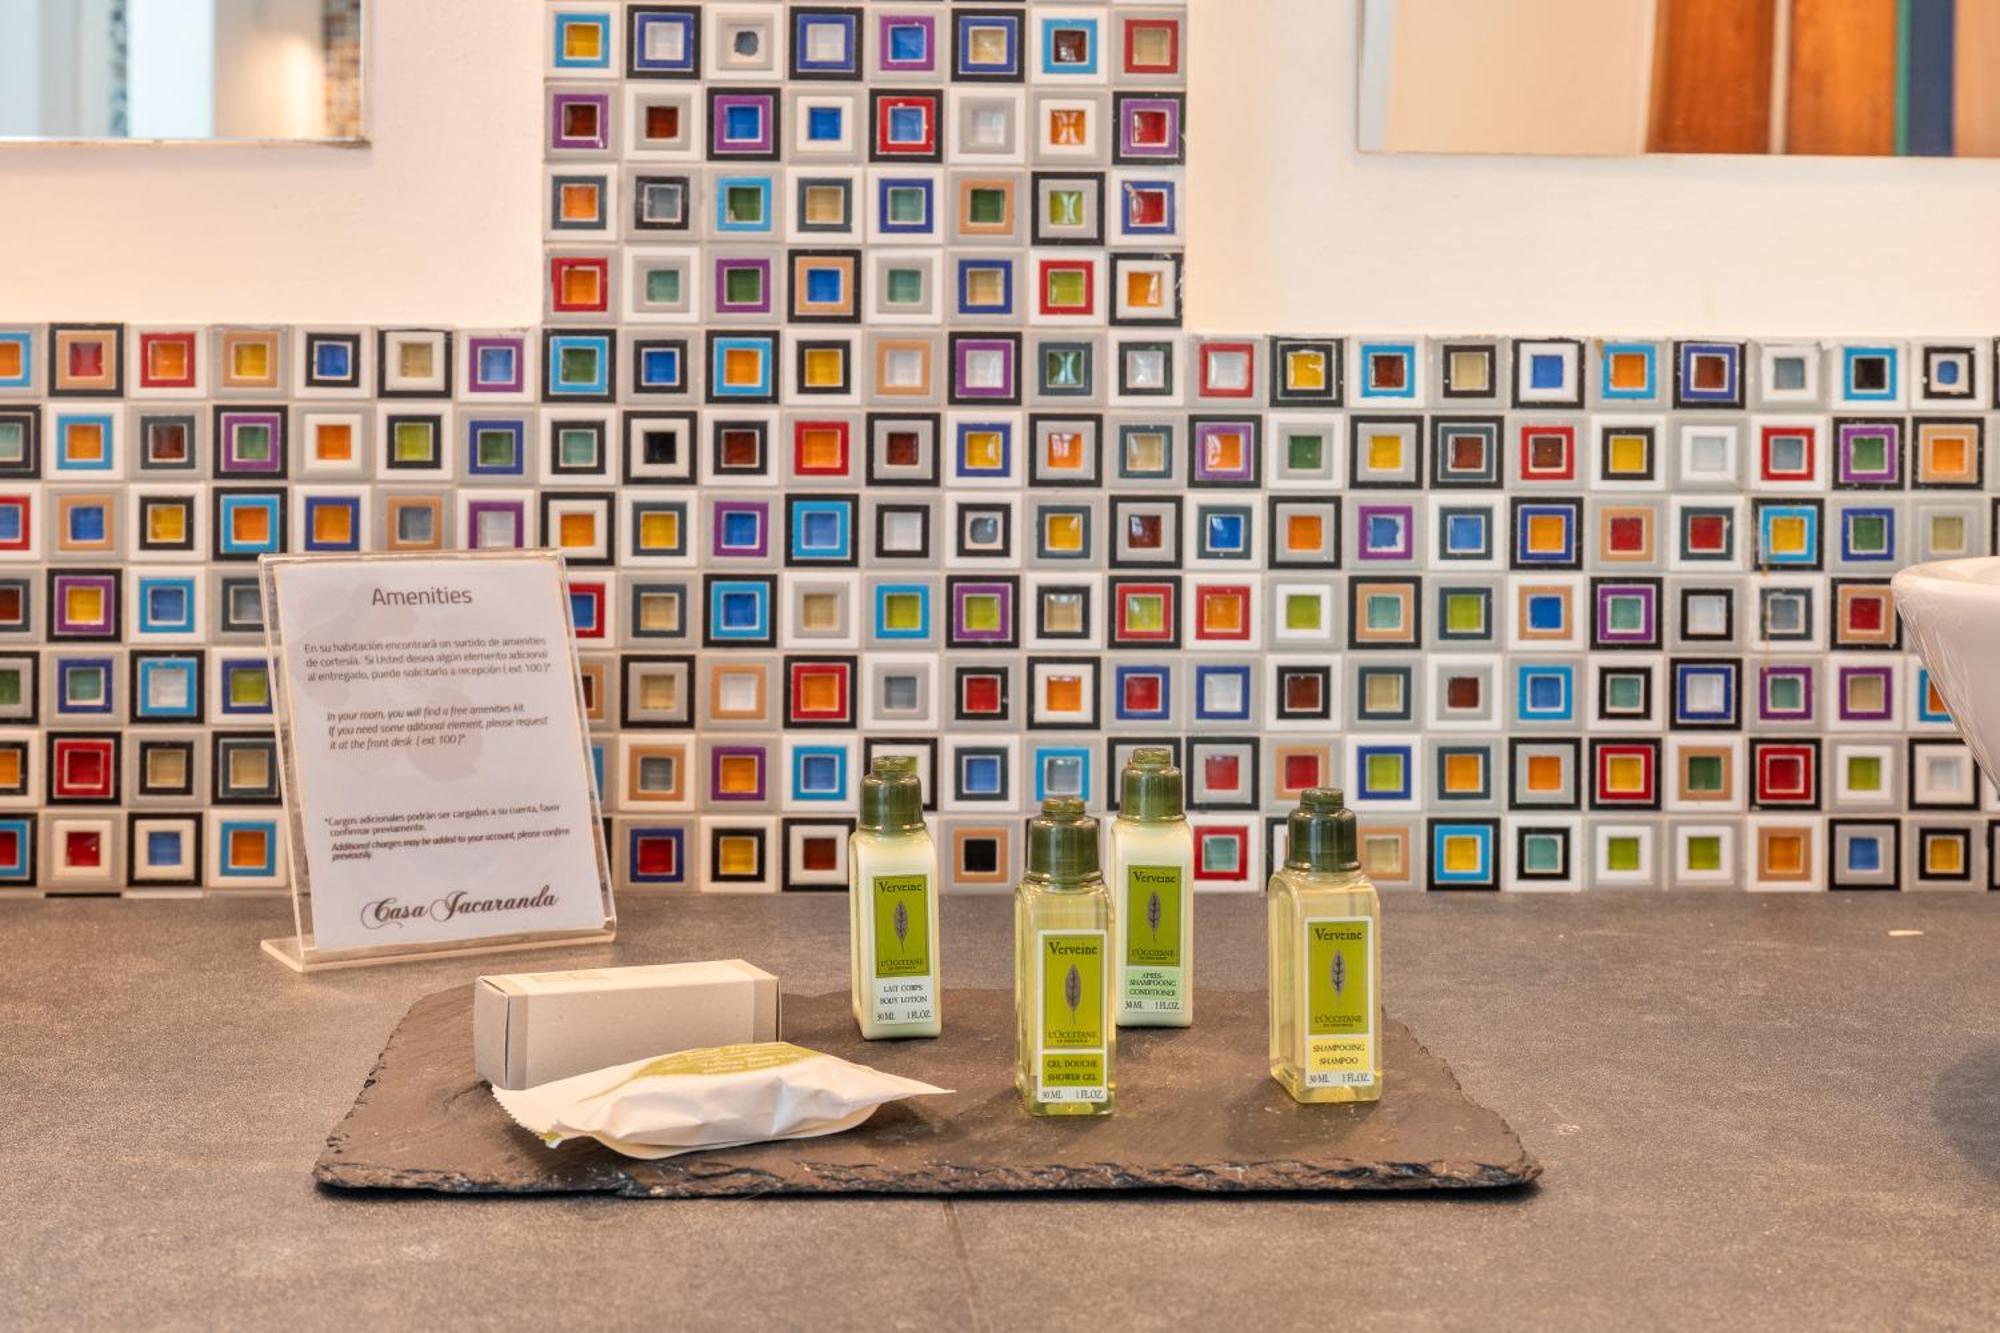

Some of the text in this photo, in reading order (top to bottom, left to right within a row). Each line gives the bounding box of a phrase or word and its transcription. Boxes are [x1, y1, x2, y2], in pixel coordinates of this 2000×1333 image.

[372, 587, 473, 606] Amenities
[304, 634, 546, 653] En su habitación encontrará un surtido de amenities
[306, 657, 318, 667] de
[376, 654, 404, 665] Usted
[406, 653, 434, 664] desea
[464, 650, 507, 661] elemento
[509, 648, 548, 660] adicional
[308, 671, 317, 682] al
[318, 669, 369, 683] entregado,
[371, 668, 400, 680] puede
[403, 665, 449, 678] solicitarlo
[450, 667, 457, 676] a
[458, 663, 502, 677] recepción
[327, 711, 336, 721] In
[338, 710, 358, 723] your
[387, 707, 405, 720] you
[406, 705, 422, 718] will
[423, 704, 441, 719] find
[442, 706, 449, 716] a
[449, 704, 468, 717] free
[470, 703, 511, 715] amenities
[328, 723, 336, 737] If
[337, 724, 354, 737] you
[355, 722, 378, 734] need
[380, 722, 405, 733] some
[447, 718, 484, 730] element,
[485, 716, 514, 731] please
[516, 715, 548, 728] request
[330, 738, 336, 750] it
[338, 739, 348, 750] at
[350, 737, 365, 749] the
[366, 736, 389, 751] front
[391, 734, 412, 747] desk
[360, 812, 405, 824] adicionales
[406, 809, 436, 823] podrán
[438, 810, 450, 819] ser
[452, 805, 489, 819] cargados
[491, 806, 497, 815] a
[498, 805, 508, 815] su
[509, 803, 538, 813] cuenta,
[540, 801, 560, 812] favor
[330, 826, 369, 837] confirmar
[331, 826, 570, 851] Additional charges may be added to your account, please confirm
[1133, 870, 1177, 884] Verveine
[878, 881, 923, 894] Verveine
[360, 884, 560, 930] Casa Jacaranda
[1314, 927, 1363, 942] Verveine
[1049, 941, 1098, 955] Verveine
[883, 984, 923, 993] LAIT CORPS
[1129, 979, 1176, 987] SHAMPOOING
[1129, 988, 1176, 997] CONDITIONER
[880, 995, 928, 1005] BODY LOTION
[1312, 1043, 1365, 1053] SHAMPOOING
[1047, 1060, 1097, 1068] GEL DOUCHE
[1320, 1056, 1359, 1065] SHAMPOO
[1047, 1072, 1097, 1081] SHOWER GEL
